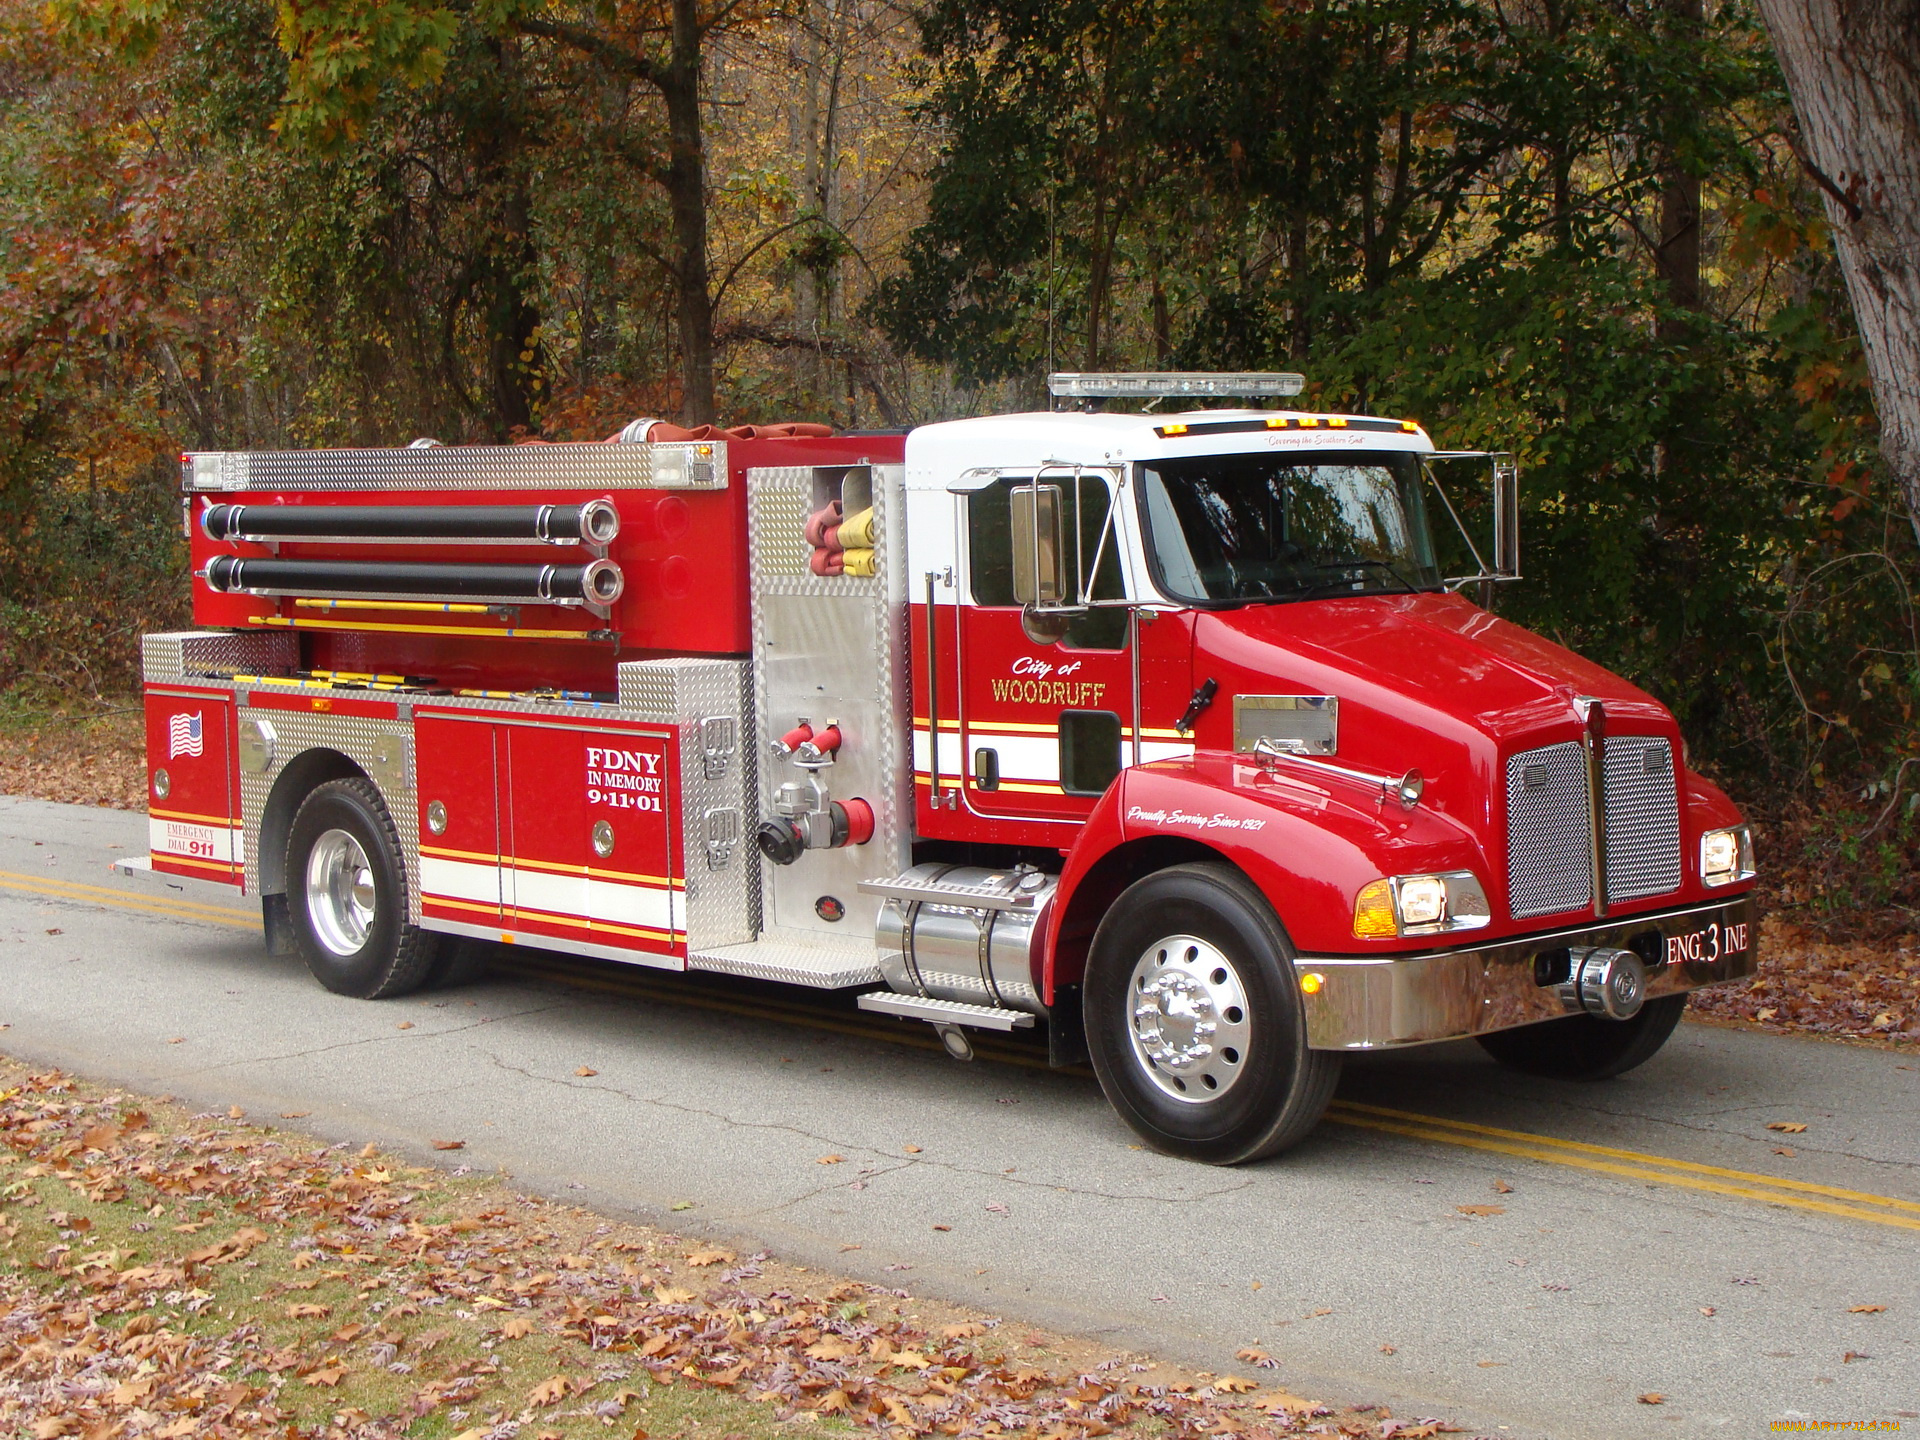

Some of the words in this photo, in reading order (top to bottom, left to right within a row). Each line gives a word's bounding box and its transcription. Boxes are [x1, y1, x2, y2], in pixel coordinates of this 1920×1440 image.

[1012, 656, 1053, 679] City
[1058, 661, 1082, 675] of
[991, 679, 1106, 706] WOODRUFF
[586, 747, 661, 774] FDNY
[587, 770, 602, 787] IN
[604, 772, 661, 793] MEMORY
[1127, 806, 1167, 826] Proudly
[1166, 809, 1208, 829] Serving
[1207, 813, 1240, 828] Since
[1240, 818, 1267, 831] 1921
[167, 823, 214, 840] EMERGENCY
[168, 839, 188, 852] DIAL
[189, 841, 214, 857] 911
